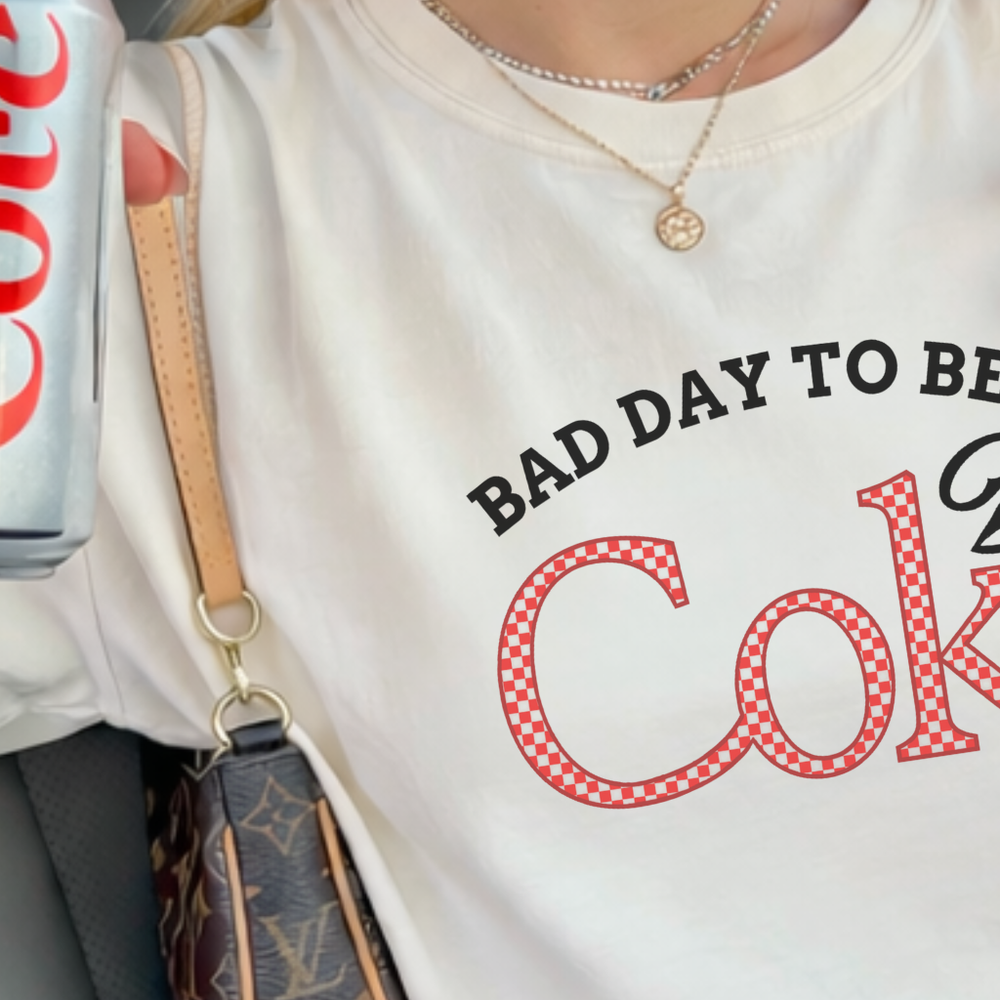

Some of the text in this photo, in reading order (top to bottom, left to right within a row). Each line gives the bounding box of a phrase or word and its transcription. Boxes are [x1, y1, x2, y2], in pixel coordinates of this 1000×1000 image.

[466, 419, 610, 537] BAD
[616, 351, 771, 448] DAY
[790, 339, 898, 399] TO
